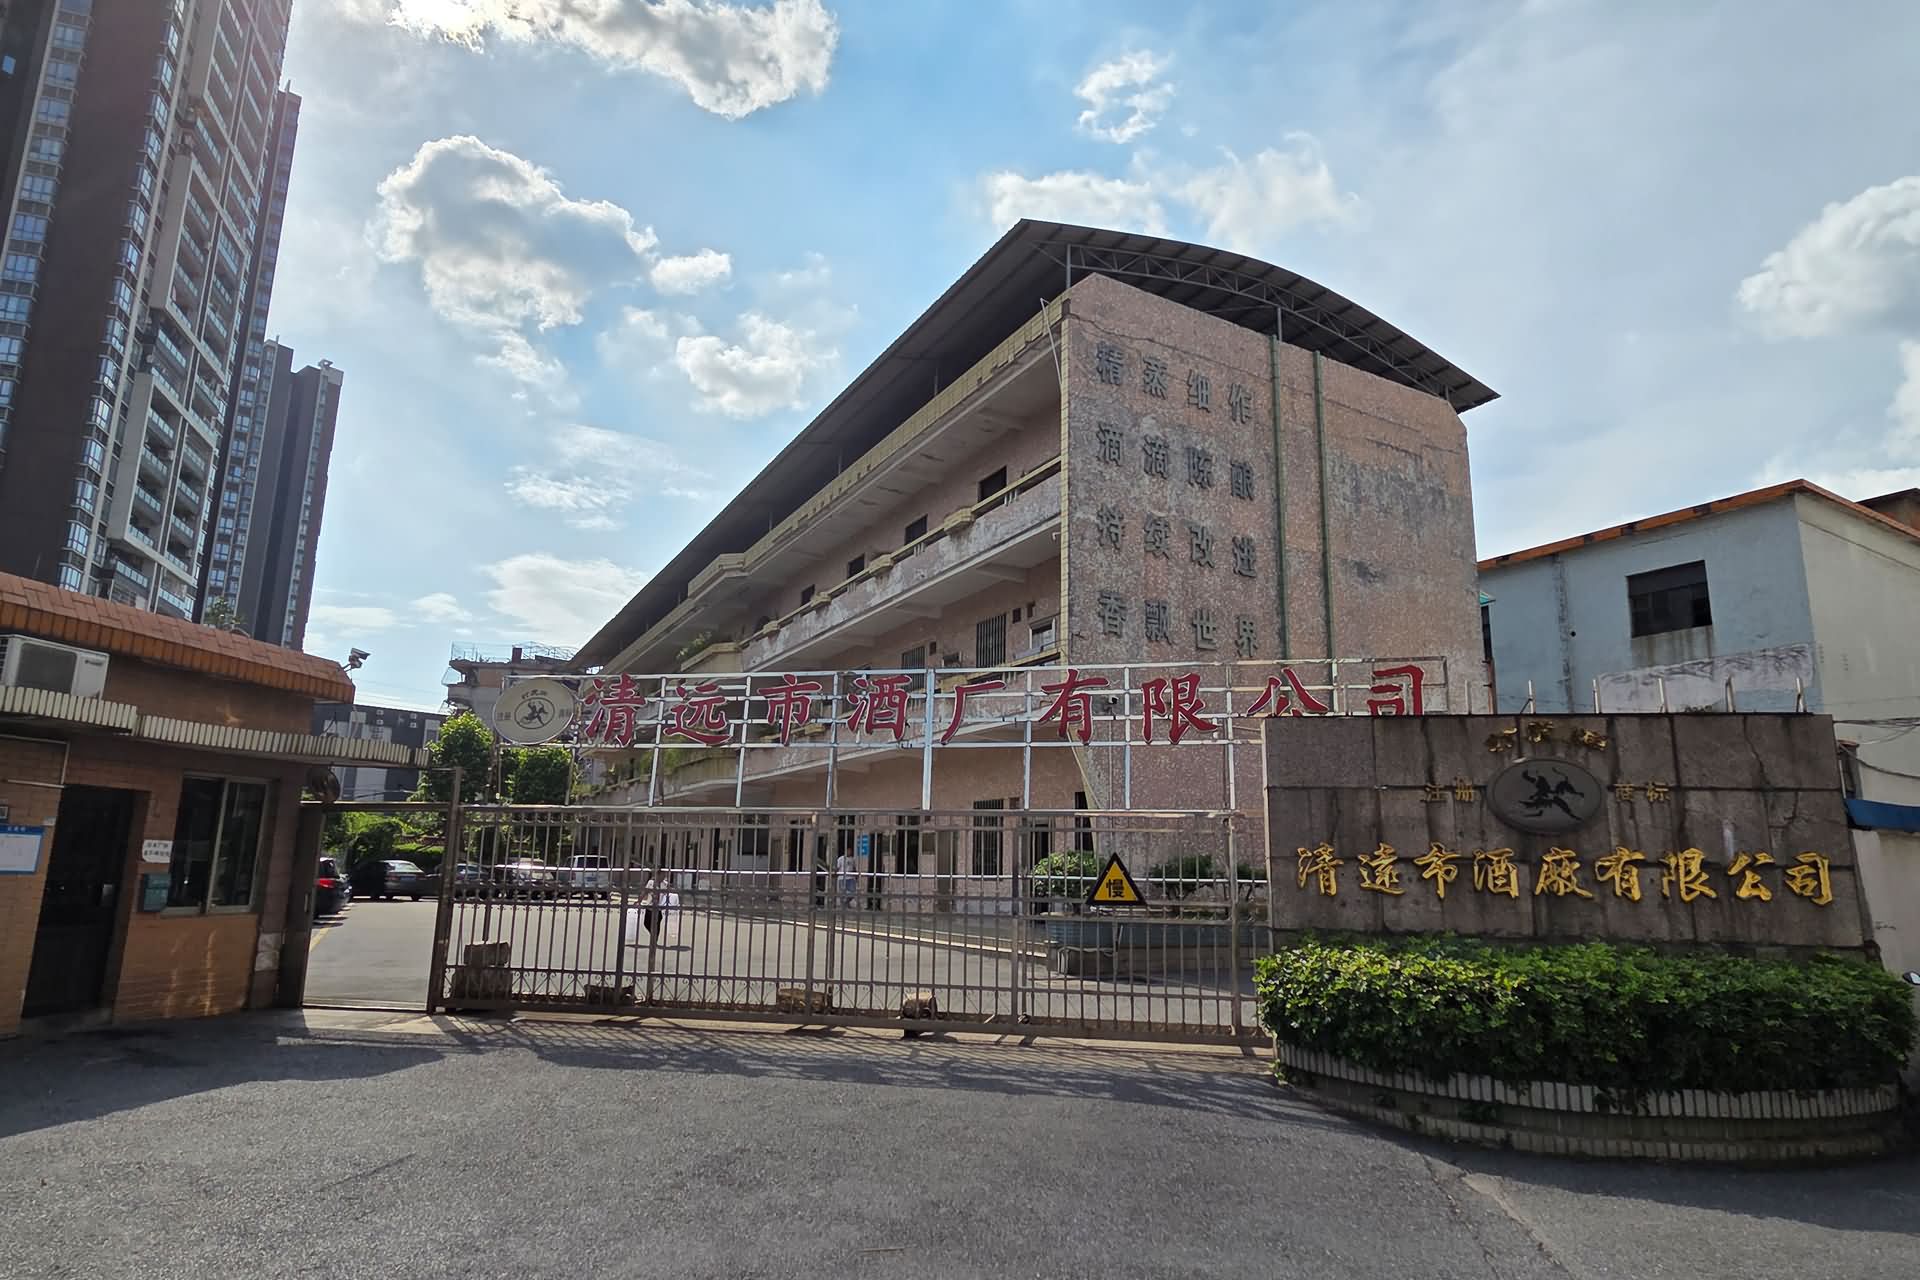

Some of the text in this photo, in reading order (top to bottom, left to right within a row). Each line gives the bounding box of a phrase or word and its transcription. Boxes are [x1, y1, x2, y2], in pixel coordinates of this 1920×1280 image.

[1097, 589, 1259, 658] 香飘世界
[583, 664, 1425, 746] 清远市酒厂有限公司
[1424, 776, 1670, 802] 注册 商标
[1105, 878, 1125, 898] 慢
